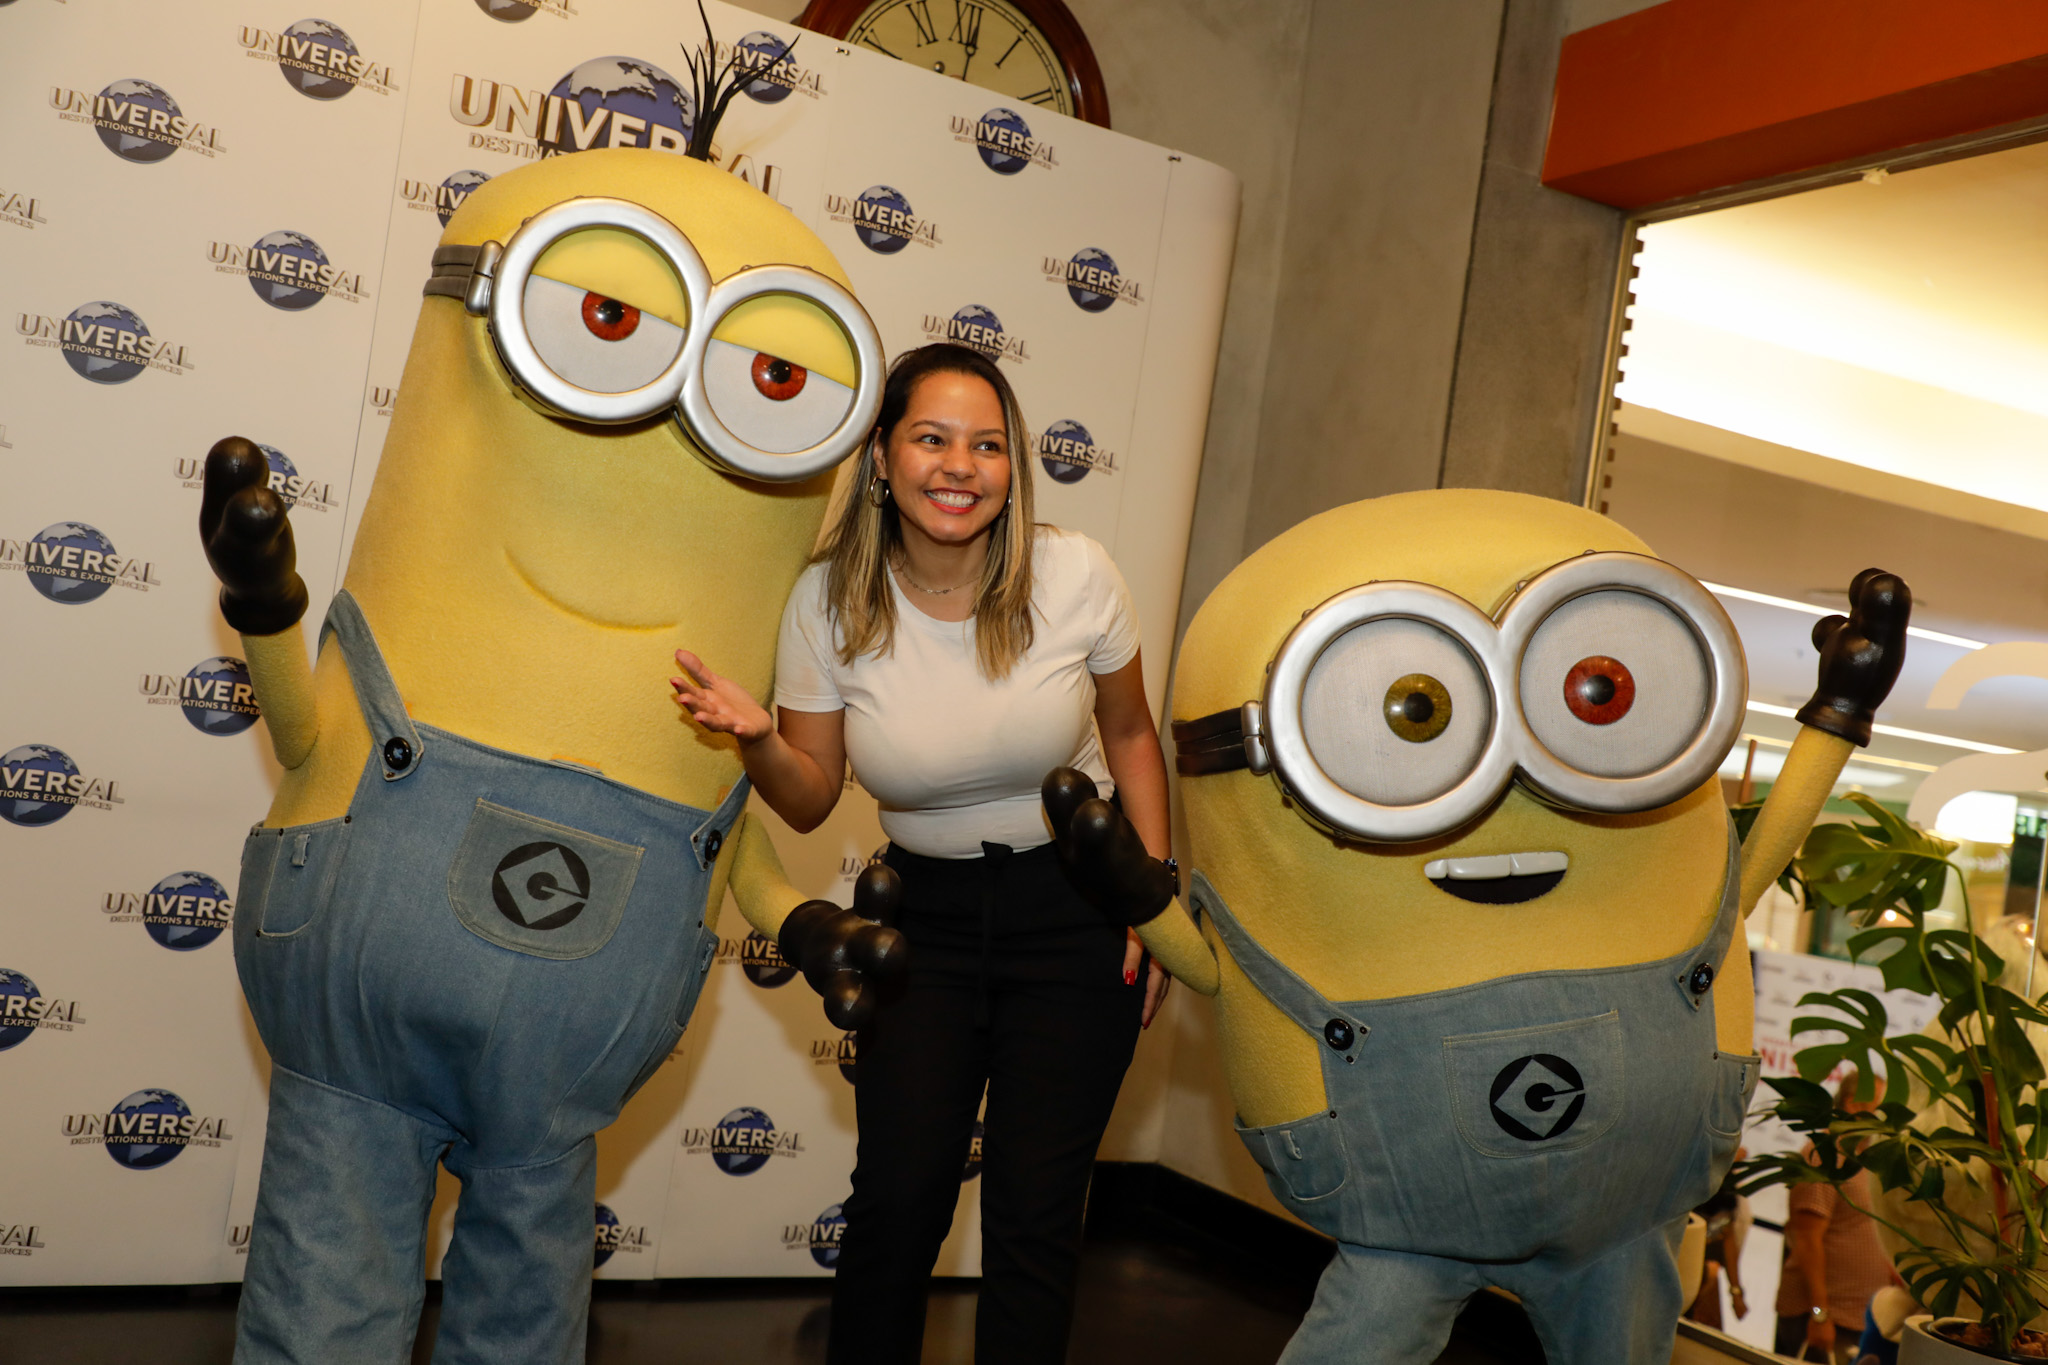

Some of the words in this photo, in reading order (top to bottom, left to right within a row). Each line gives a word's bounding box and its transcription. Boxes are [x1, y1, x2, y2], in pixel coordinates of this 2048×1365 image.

[237, 25, 399, 91] UNIVERSAL
[49, 86, 227, 153] UNIVERSAL
[949, 115, 1059, 166] UNIVERSAL
[824, 192, 943, 245] UNIVERSAL
[206, 240, 370, 298] UNIVERSAL
[1041, 255, 1145, 302] UNIVERSAL
[15, 312, 195, 370] UNIVERSAL
[921, 313, 1031, 360] UNIVERSAL
[1030, 433, 1119, 471] NIVERSAL
[0, 539, 160, 586] NIVERSAL
[0, 562, 66, 577] ESTINATIONS
[138, 674, 258, 706] UNIVER
[1, 767, 125, 804] VERSAL
[101, 892, 235, 921] UNIVERS
[61, 1113, 233, 1141] UNIVERSAL
[680, 1127, 805, 1152] UNIVERSAL
